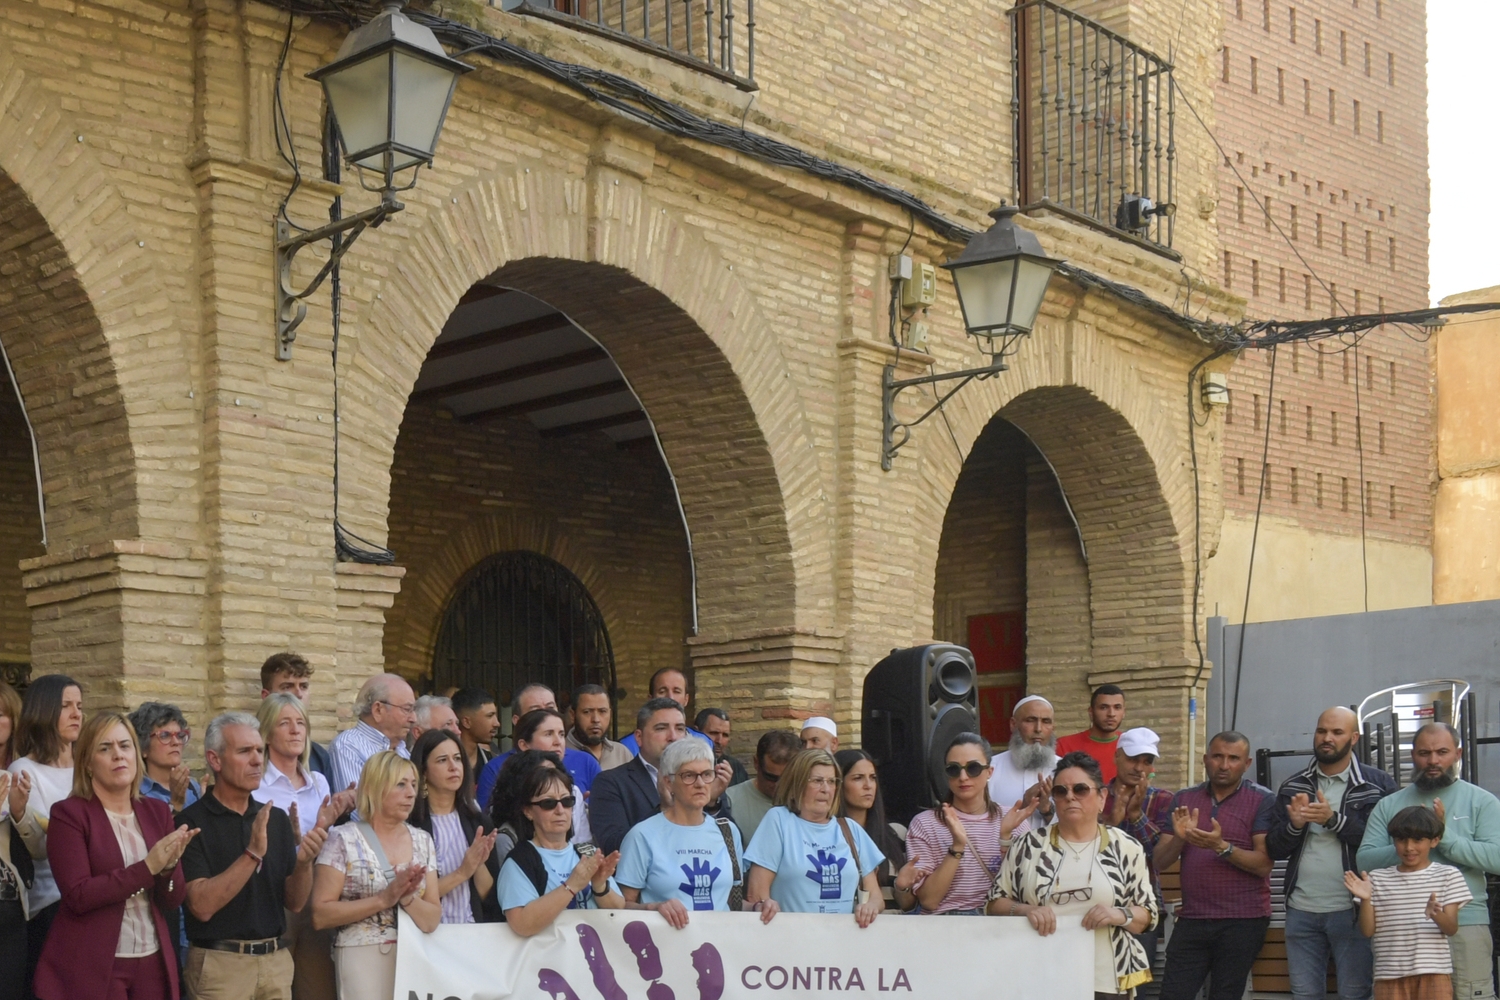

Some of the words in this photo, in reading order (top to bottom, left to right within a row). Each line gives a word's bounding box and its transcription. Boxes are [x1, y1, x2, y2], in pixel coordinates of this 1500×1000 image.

[694, 874, 712, 888] NO
[740, 965, 866, 991] CONTRA
[878, 968, 913, 992] LA
